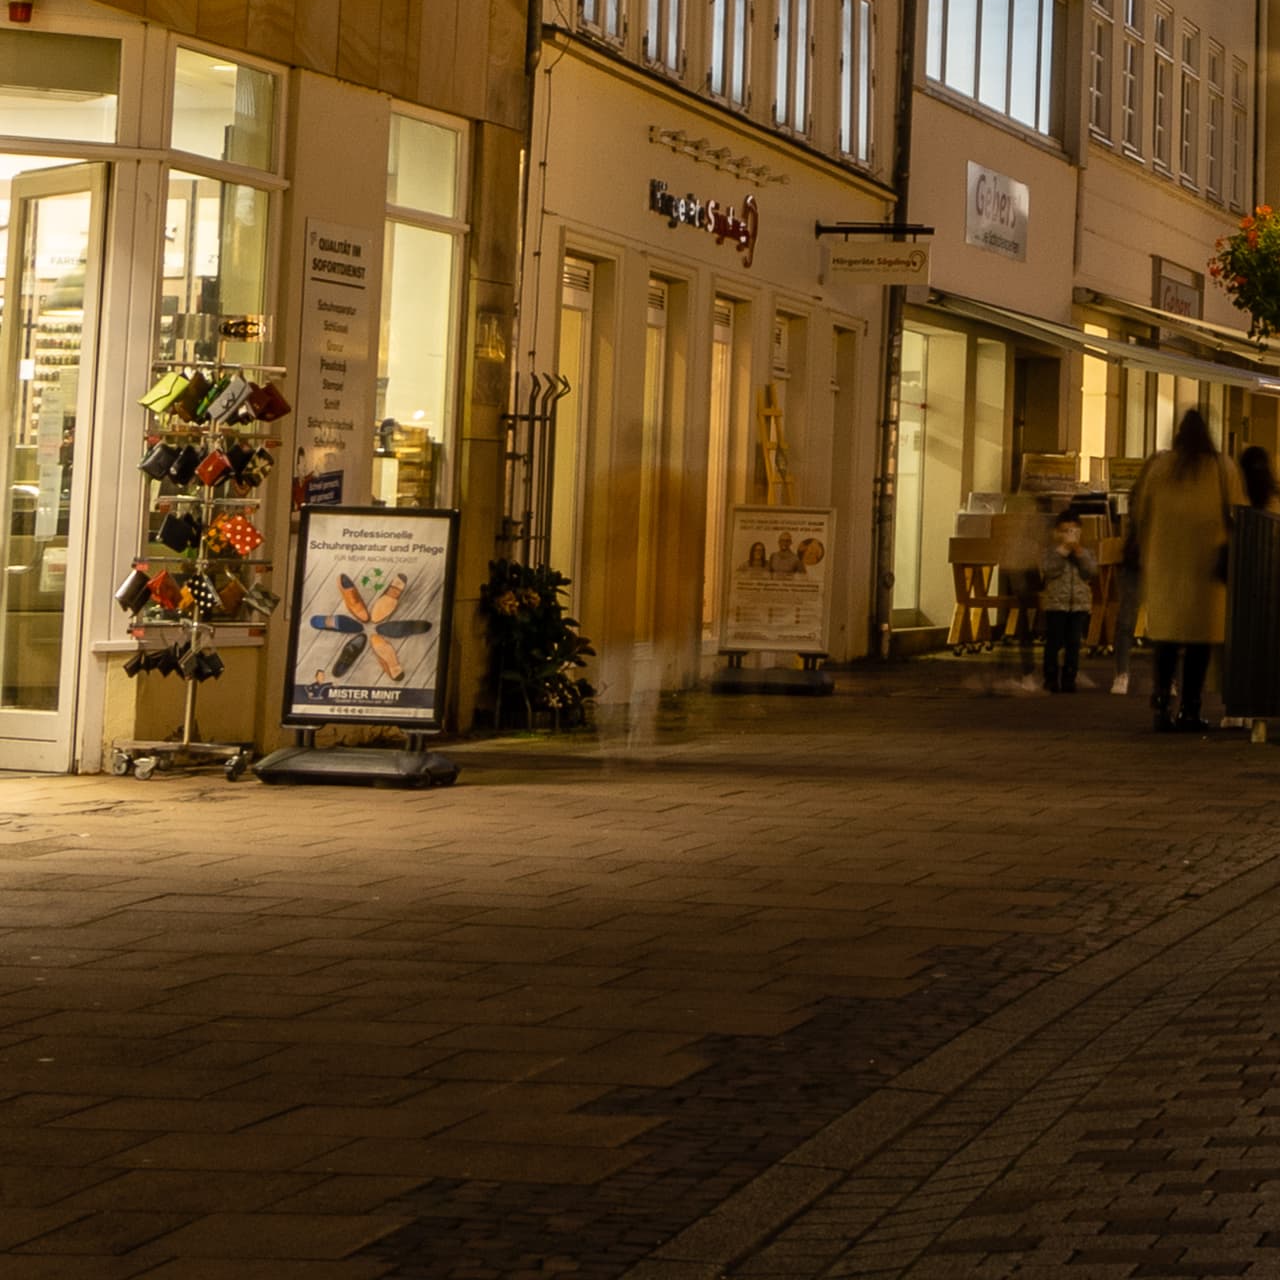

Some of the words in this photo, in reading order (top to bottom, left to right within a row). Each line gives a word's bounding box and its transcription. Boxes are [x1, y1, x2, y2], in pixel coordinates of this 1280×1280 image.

[319, 237, 351, 257] QUALITÄT
[312, 257, 366, 280] SOFORTDIENST
[342, 528, 413, 540] Professionelle
[310, 540, 387, 552] Schuhreparatur
[390, 544, 409, 553] und
[412, 544, 444, 556] Pflege
[327, 688, 368, 700] MISTER
[371, 689, 402, 701] MINIT
